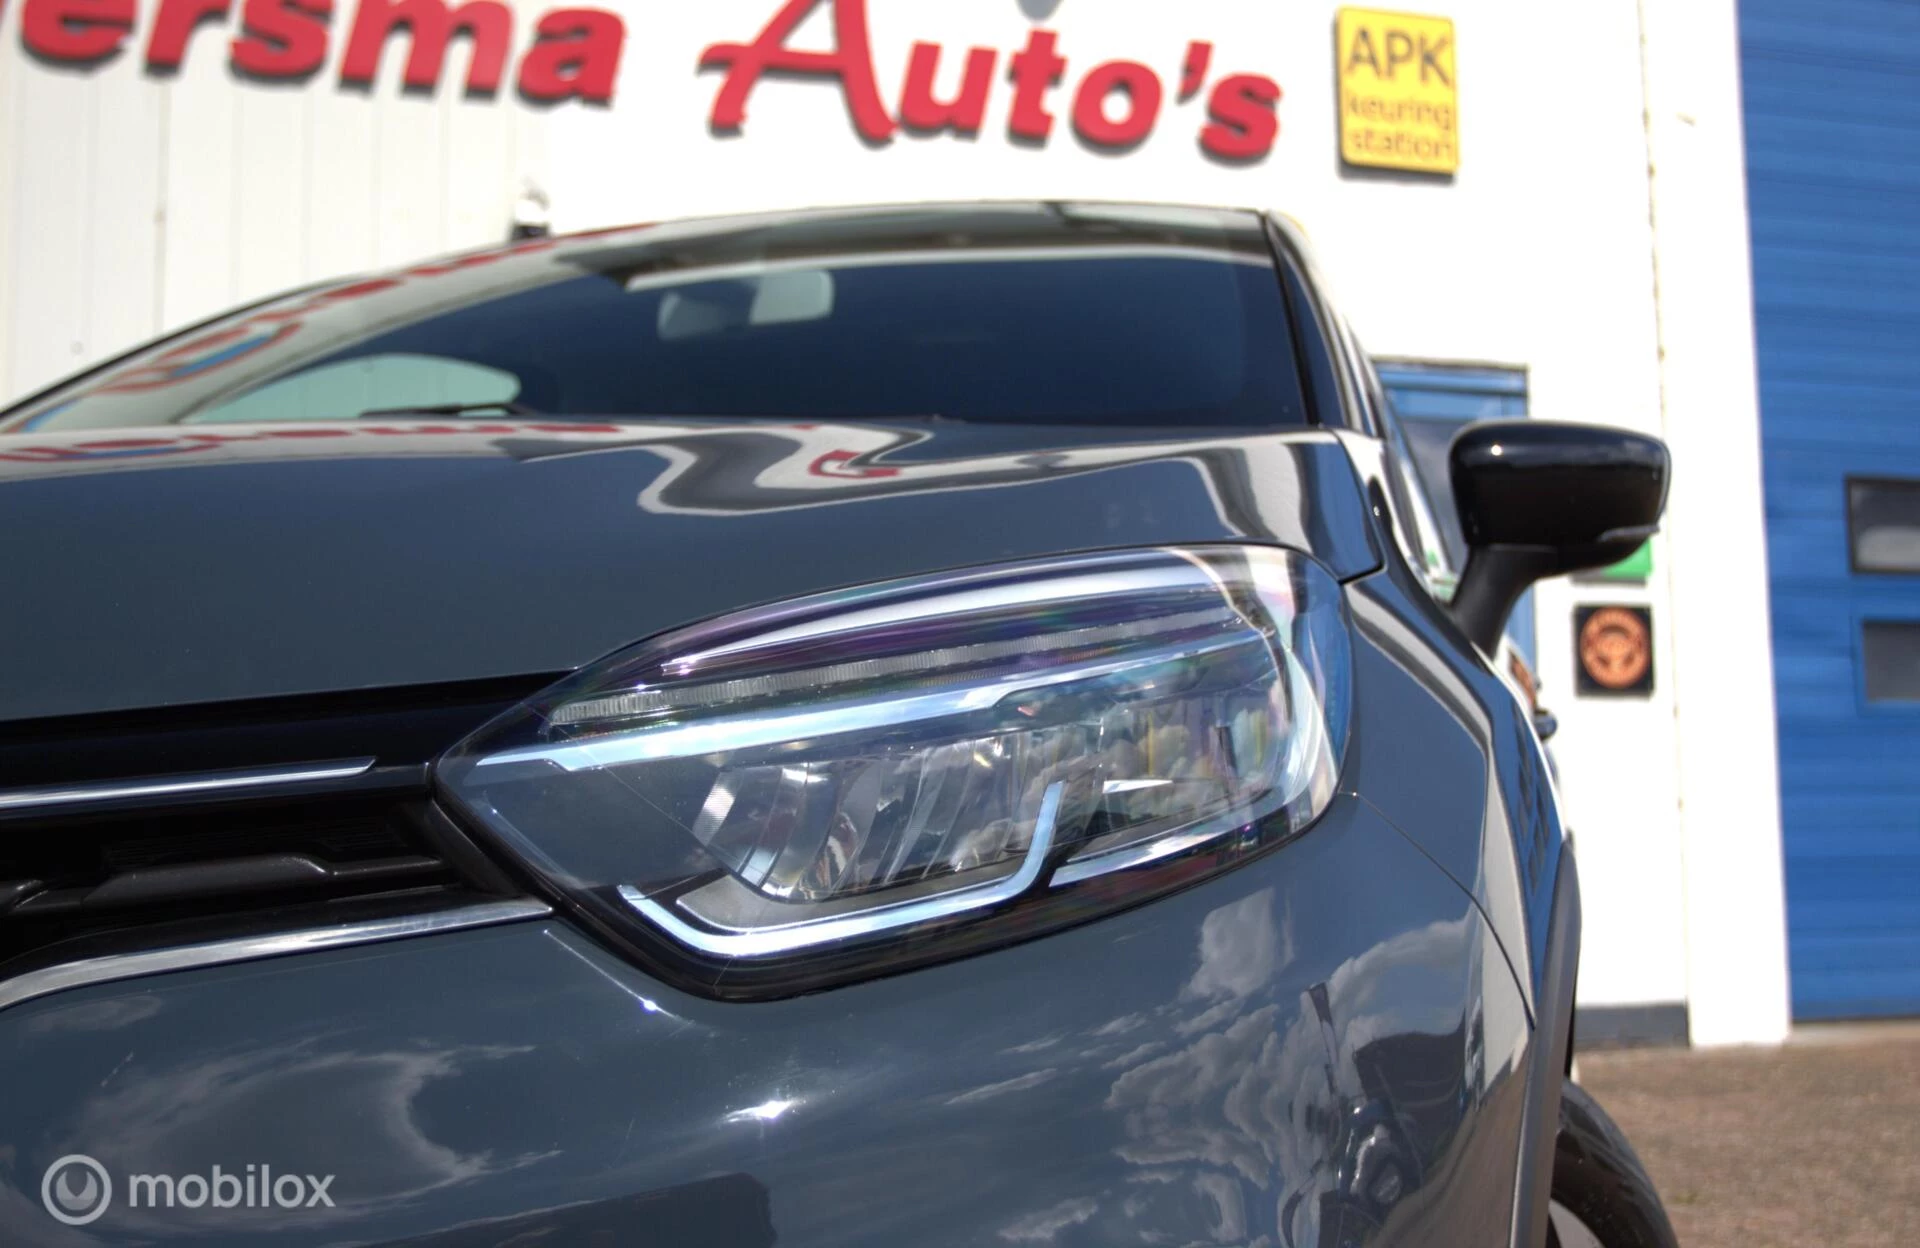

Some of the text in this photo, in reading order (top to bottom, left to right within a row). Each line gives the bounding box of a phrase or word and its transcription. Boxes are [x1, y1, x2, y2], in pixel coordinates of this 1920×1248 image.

[1345, 26, 1454, 87] APK
[0, 0, 1283, 164] ersma Auto's
[1348, 95, 1453, 132] keuring
[1351, 129, 1454, 160] station
